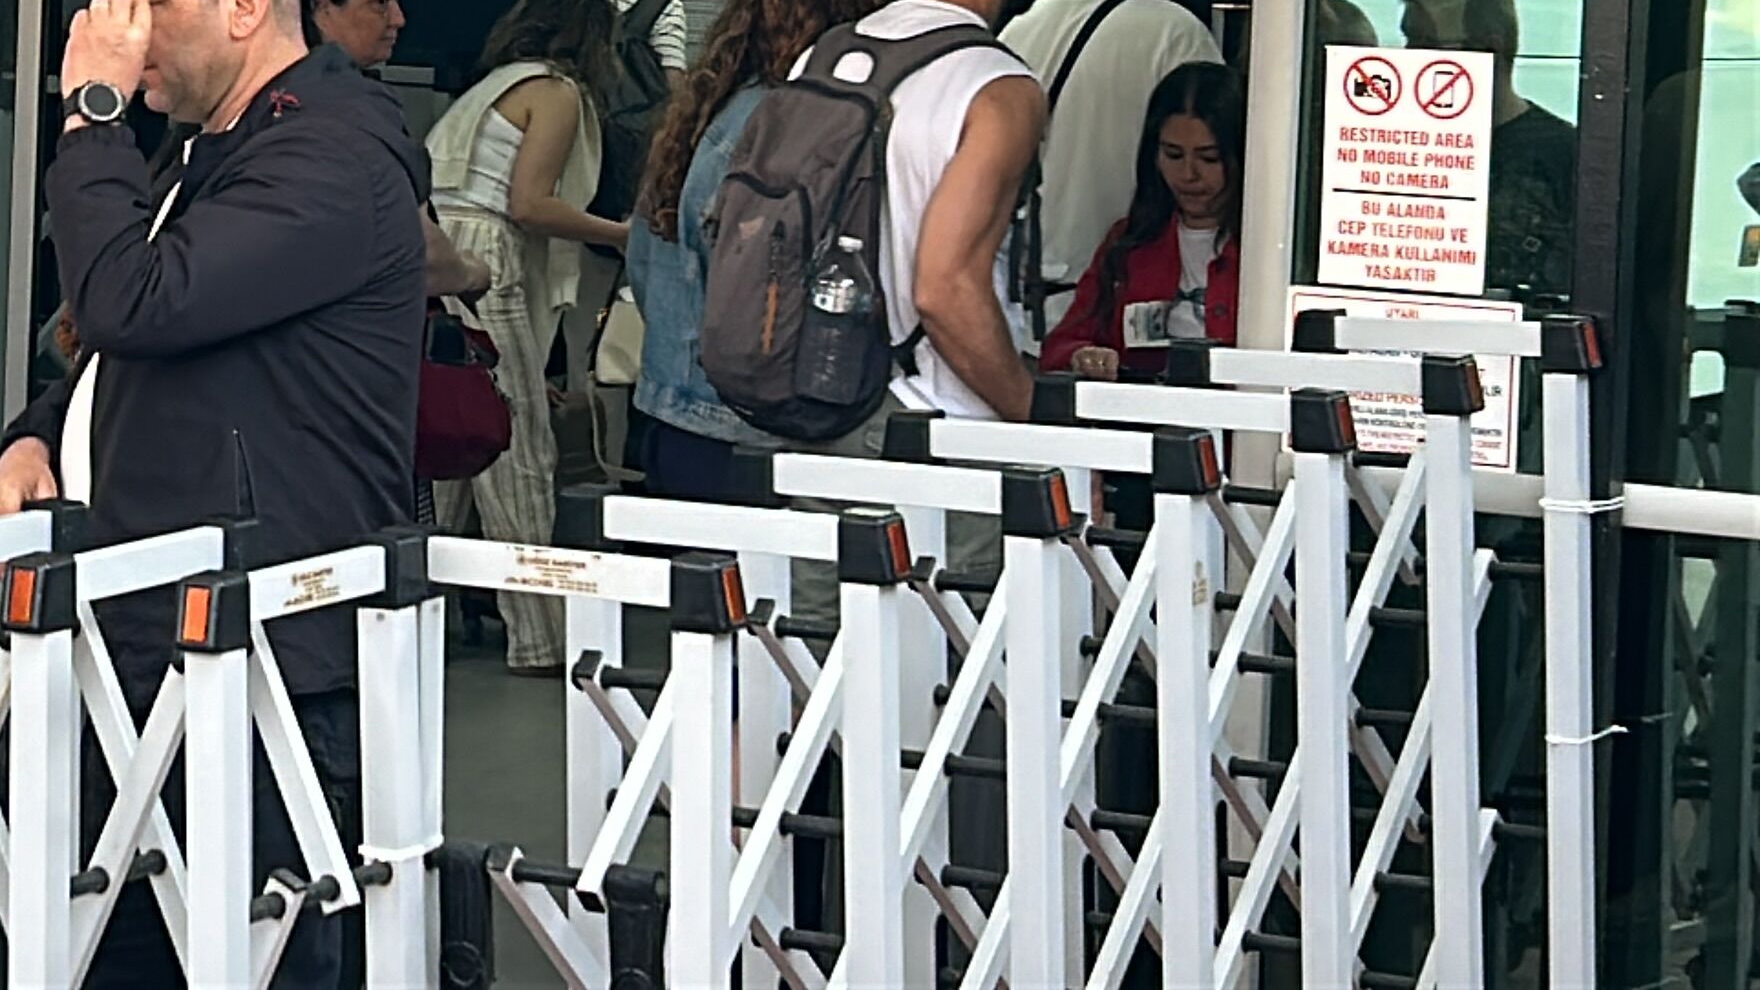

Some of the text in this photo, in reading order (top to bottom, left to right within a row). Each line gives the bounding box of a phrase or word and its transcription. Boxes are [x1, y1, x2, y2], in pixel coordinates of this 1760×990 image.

[1339, 127, 1474, 149] RESTRICTED AREA
[1337, 148, 1475, 170] NO MOBILE PHONE
[1361, 170, 1448, 189] NO CAMERA
[1362, 200, 1446, 220] BU ALANDA
[1338, 220, 1468, 243] CEP TELEFONU VE
[1328, 240, 1476, 265] KAMERA KULLANIMI
[1365, 264, 1436, 282] YASAKTIR
